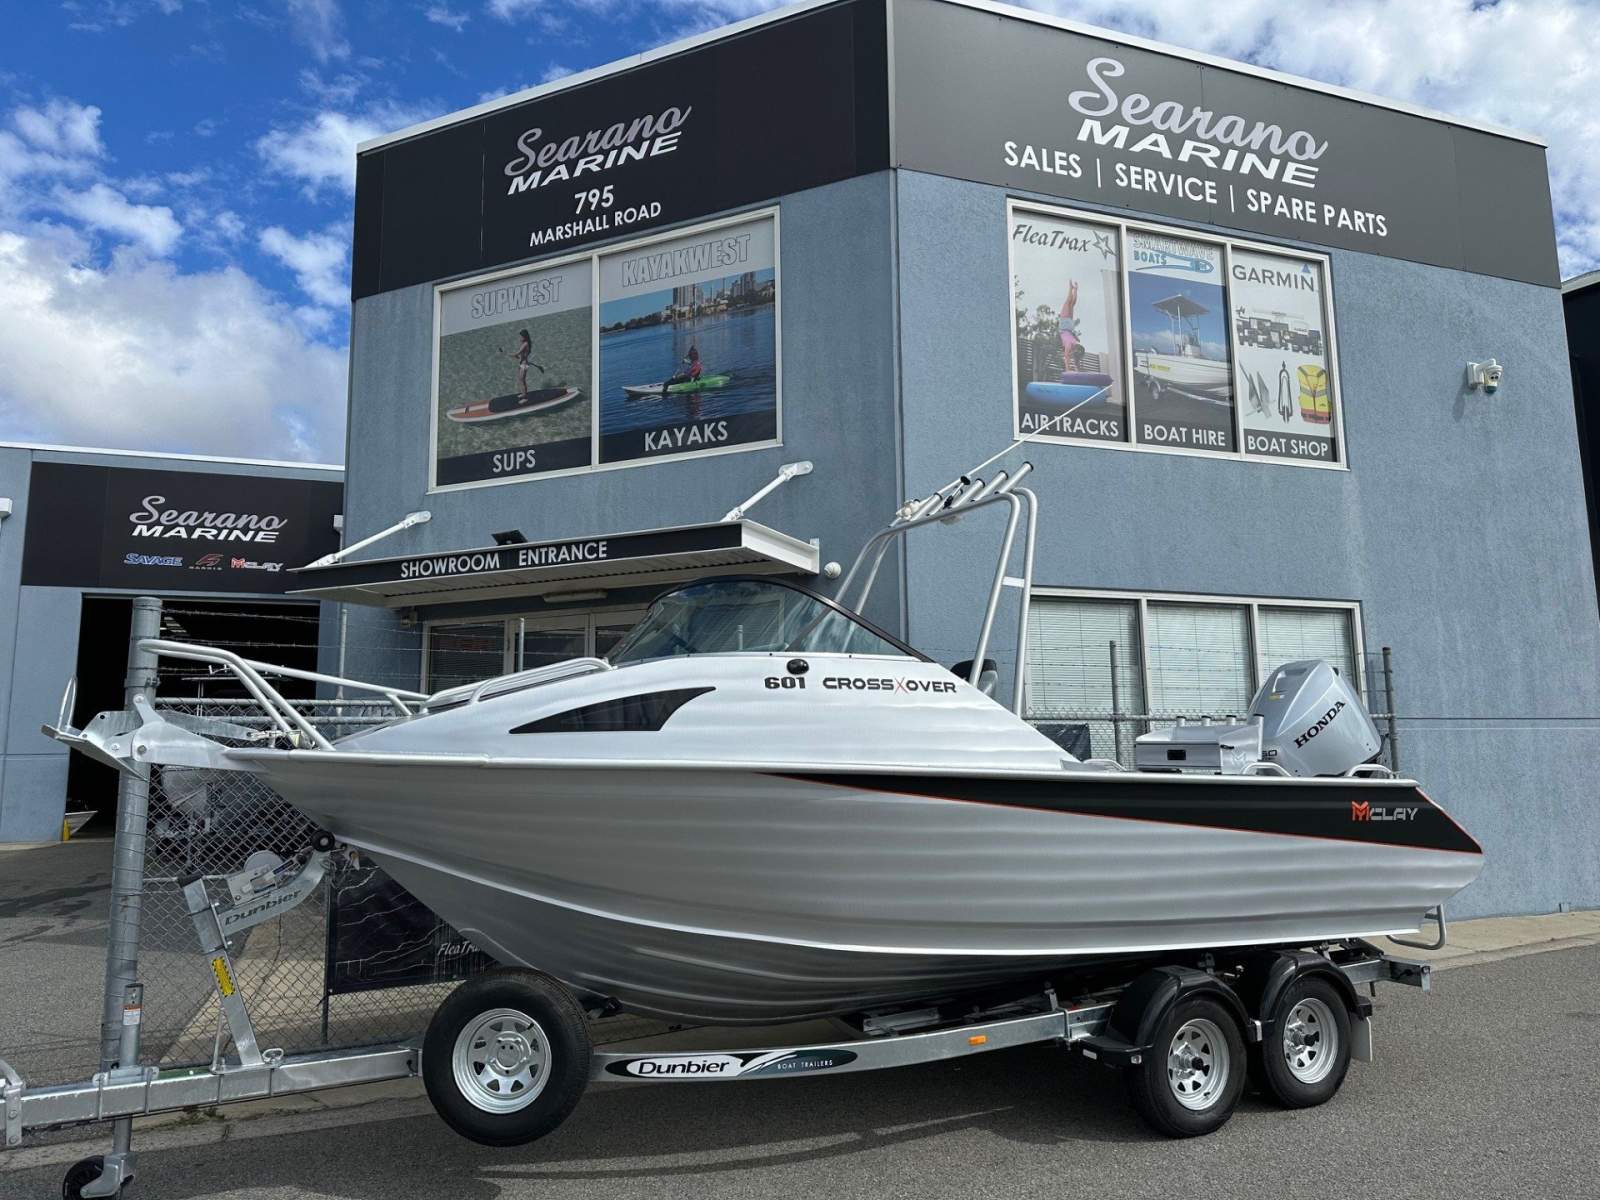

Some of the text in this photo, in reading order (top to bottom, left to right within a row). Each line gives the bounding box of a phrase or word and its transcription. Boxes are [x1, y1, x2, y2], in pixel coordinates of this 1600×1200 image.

[1068, 57, 1328, 160] Searano
[504, 105, 692, 177] Searano
[1077, 118, 1320, 189] MARINE
[508, 131, 681, 195] MARINE
[574, 185, 614, 214] 795
[1004, 141, 1388, 237] SALES SERVICE SPARE PARTS
[529, 202, 661, 247] MARSHALL ROAD
[1013, 224, 1090, 252] FleaTrax
[622, 234, 750, 288] KAYAKWEST
[1133, 250, 1167, 265] BOATS
[1232, 264, 1314, 292] GARMIN
[472, 275, 563, 318] SUPWEST
[644, 421, 728, 451] KAYAKS
[1021, 412, 1119, 437] AIR TRACKS
[1144, 424, 1226, 447] BOAT HIRE
[1248, 435, 1329, 457] BOAT SHOP
[492, 450, 536, 473] SUPS
[129, 495, 288, 531] Searano
[131, 524, 280, 543] MARINE
[124, 552, 183, 567] SAVAGE
[400, 540, 608, 578] SHOWROOM ENTRANCE
[764, 677, 957, 694] 601 CROSSXOVER
[1294, 701, 1346, 749] HONDA
[225, 889, 301, 925] Dunbier
[638, 1060, 729, 1075] Dunbier
[777, 1059, 833, 1070] BOAT TRAILERS
